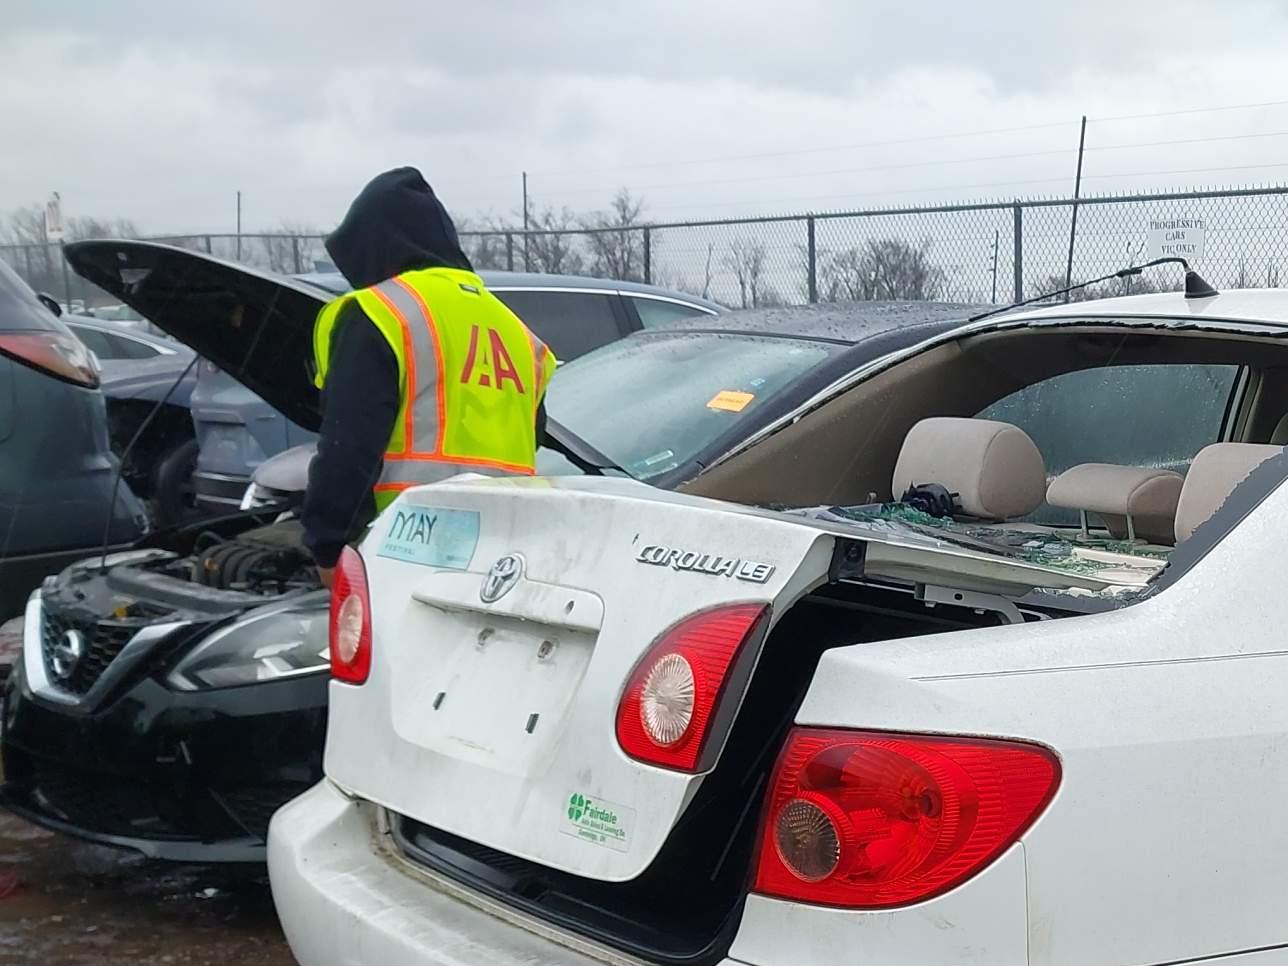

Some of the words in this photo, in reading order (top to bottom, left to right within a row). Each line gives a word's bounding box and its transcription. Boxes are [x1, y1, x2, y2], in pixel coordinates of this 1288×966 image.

[388, 511, 438, 545] MAY
[635, 544, 741, 578] COROLLA
[737, 560, 774, 582] LE
[583, 799, 618, 825] Fairdale
